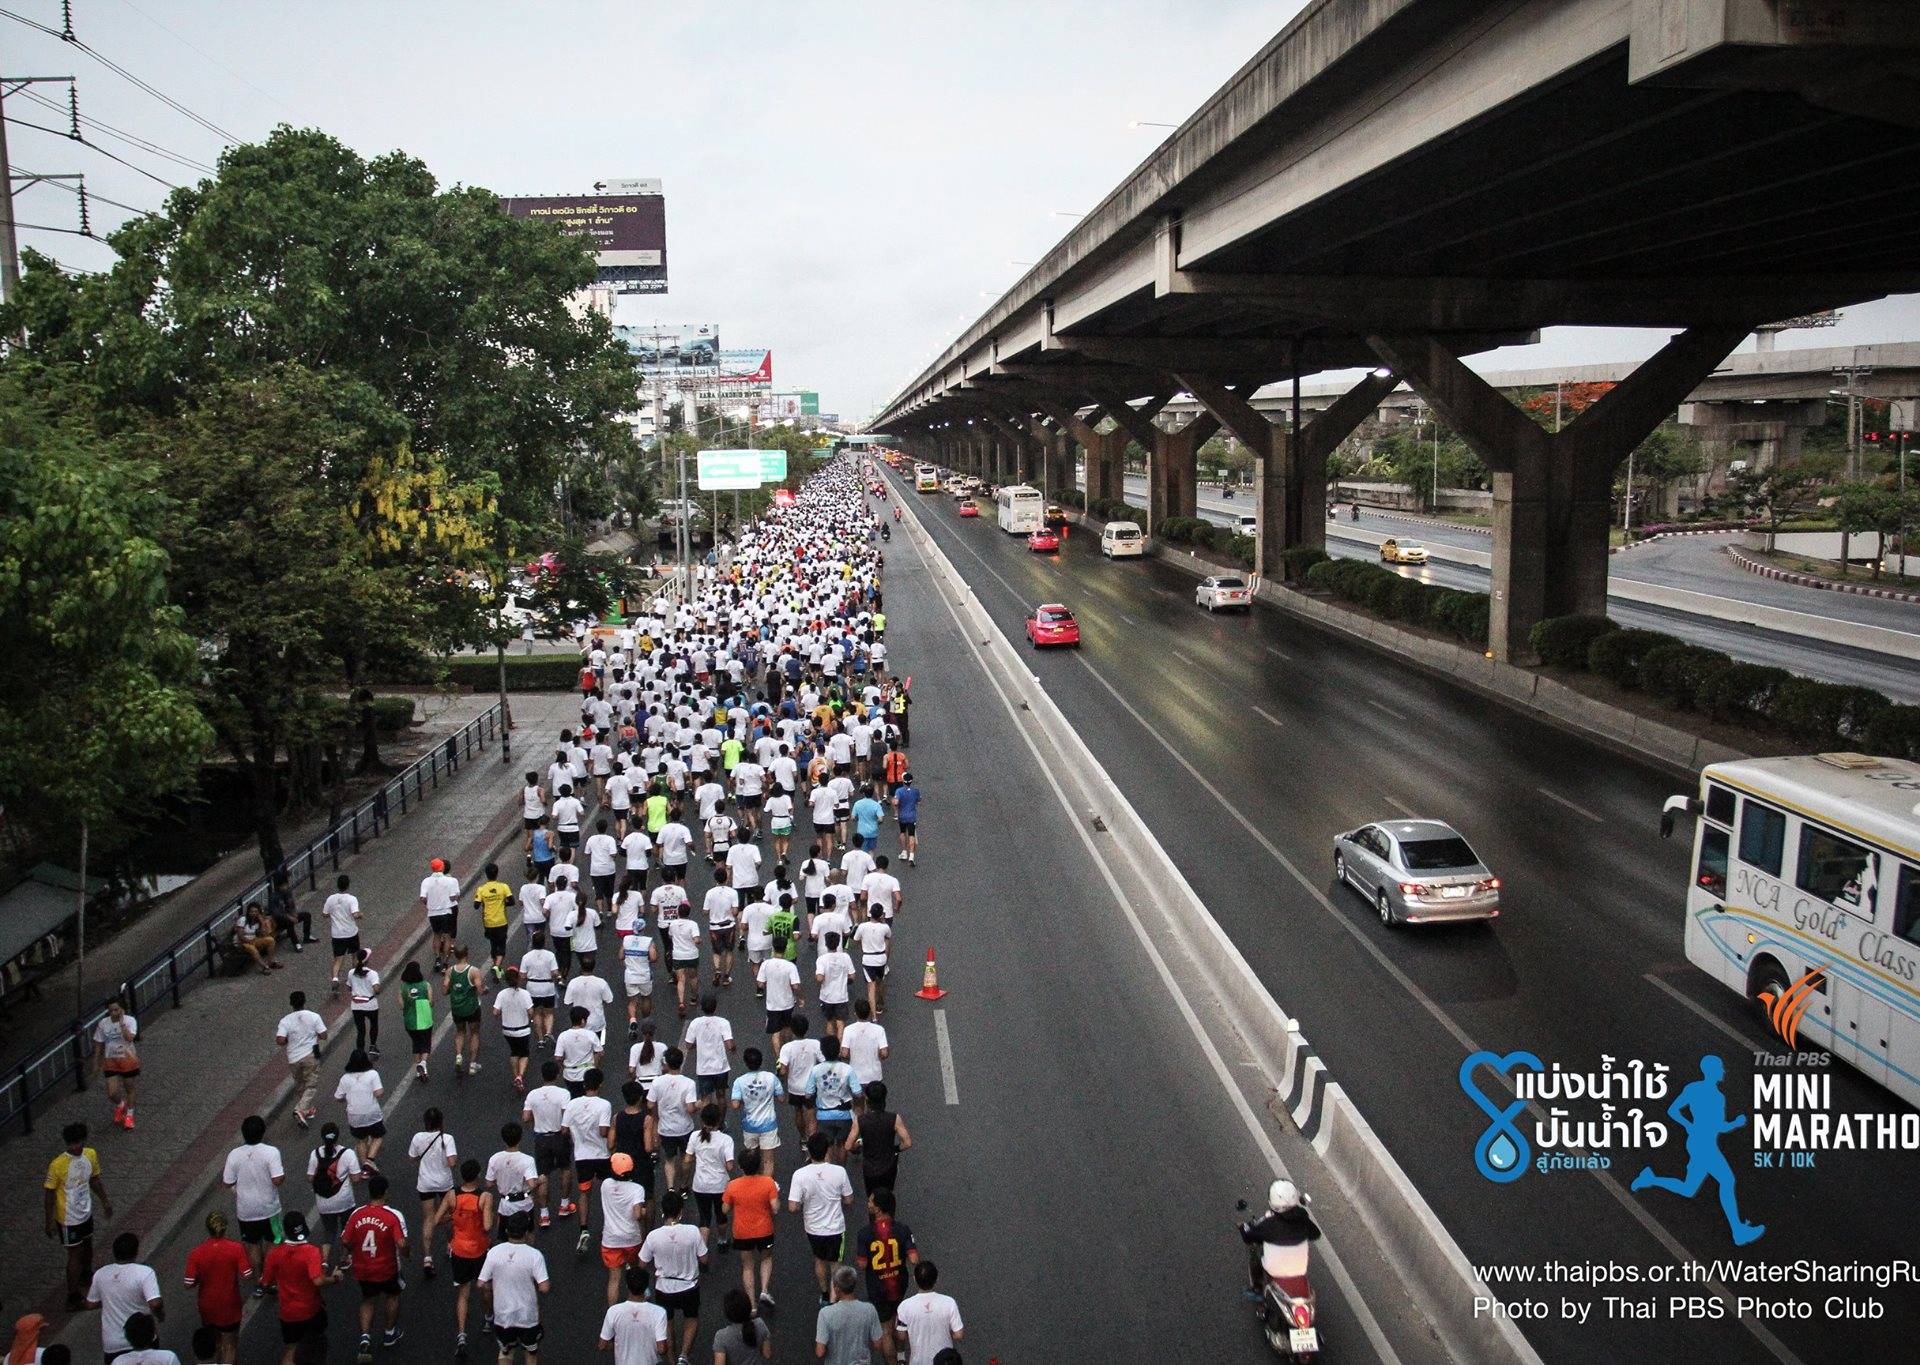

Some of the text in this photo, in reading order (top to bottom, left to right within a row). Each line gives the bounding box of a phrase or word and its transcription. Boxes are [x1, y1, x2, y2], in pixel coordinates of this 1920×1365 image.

[1736, 869, 1917, 981] NCA Gold Class
[362, 1230, 377, 1258] 4
[870, 1238, 902, 1270] 21
